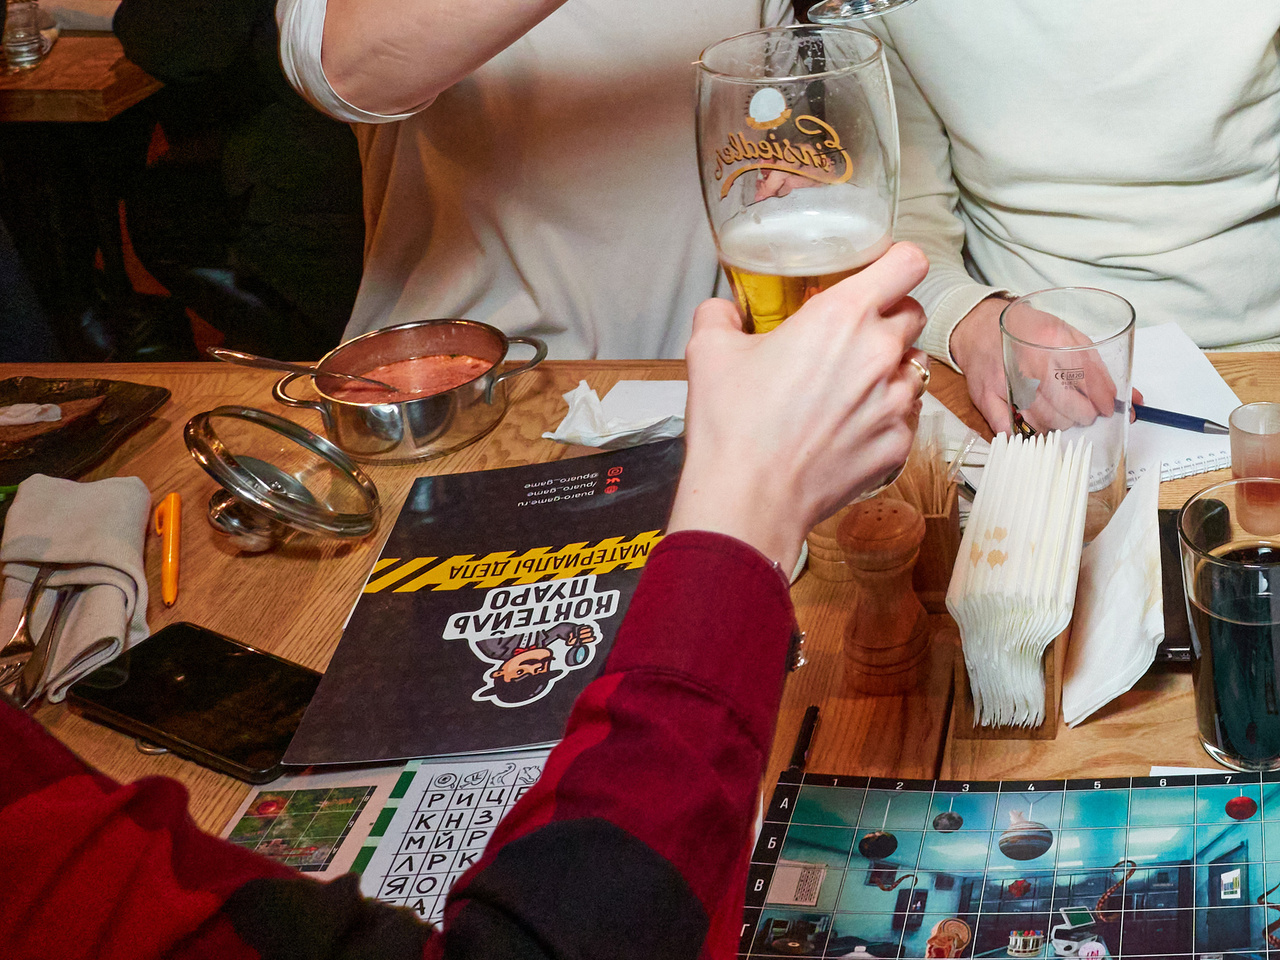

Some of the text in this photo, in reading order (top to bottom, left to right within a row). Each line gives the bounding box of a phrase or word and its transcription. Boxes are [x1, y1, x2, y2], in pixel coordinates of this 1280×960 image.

[523, 472, 599, 489] @puaro_game
[517, 489, 595, 507] puaro-game.ru
[449, 541, 651, 581] МАТЕРИАЛЫ ДЕЛА
[490, 577, 588, 610] ПУАРО
[454, 594, 613, 640] КОКТЕЙЛЬ
[832, 778, 838, 786] 1
[896, 781, 904, 790] 2
[962, 783, 970, 792] 3
[1027, 783, 1035, 791] 4
[1094, 780, 1102, 789] 5
[1159, 778, 1167, 787] 6
[1224, 776, 1232, 784] 7
[428, 793, 445, 808] Р
[456, 793, 474, 807] И
[486, 788, 505, 804] Ц
[780, 797, 789, 809] А
[415, 810, 493, 830] К Н З
[405, 830, 488, 851] М Й Р
[767, 837, 777, 849] Б
[427, 854, 447, 870] Р
[385, 876, 438, 896] Я О
[754, 879, 764, 891] В
[740, 923, 750, 937] Г
